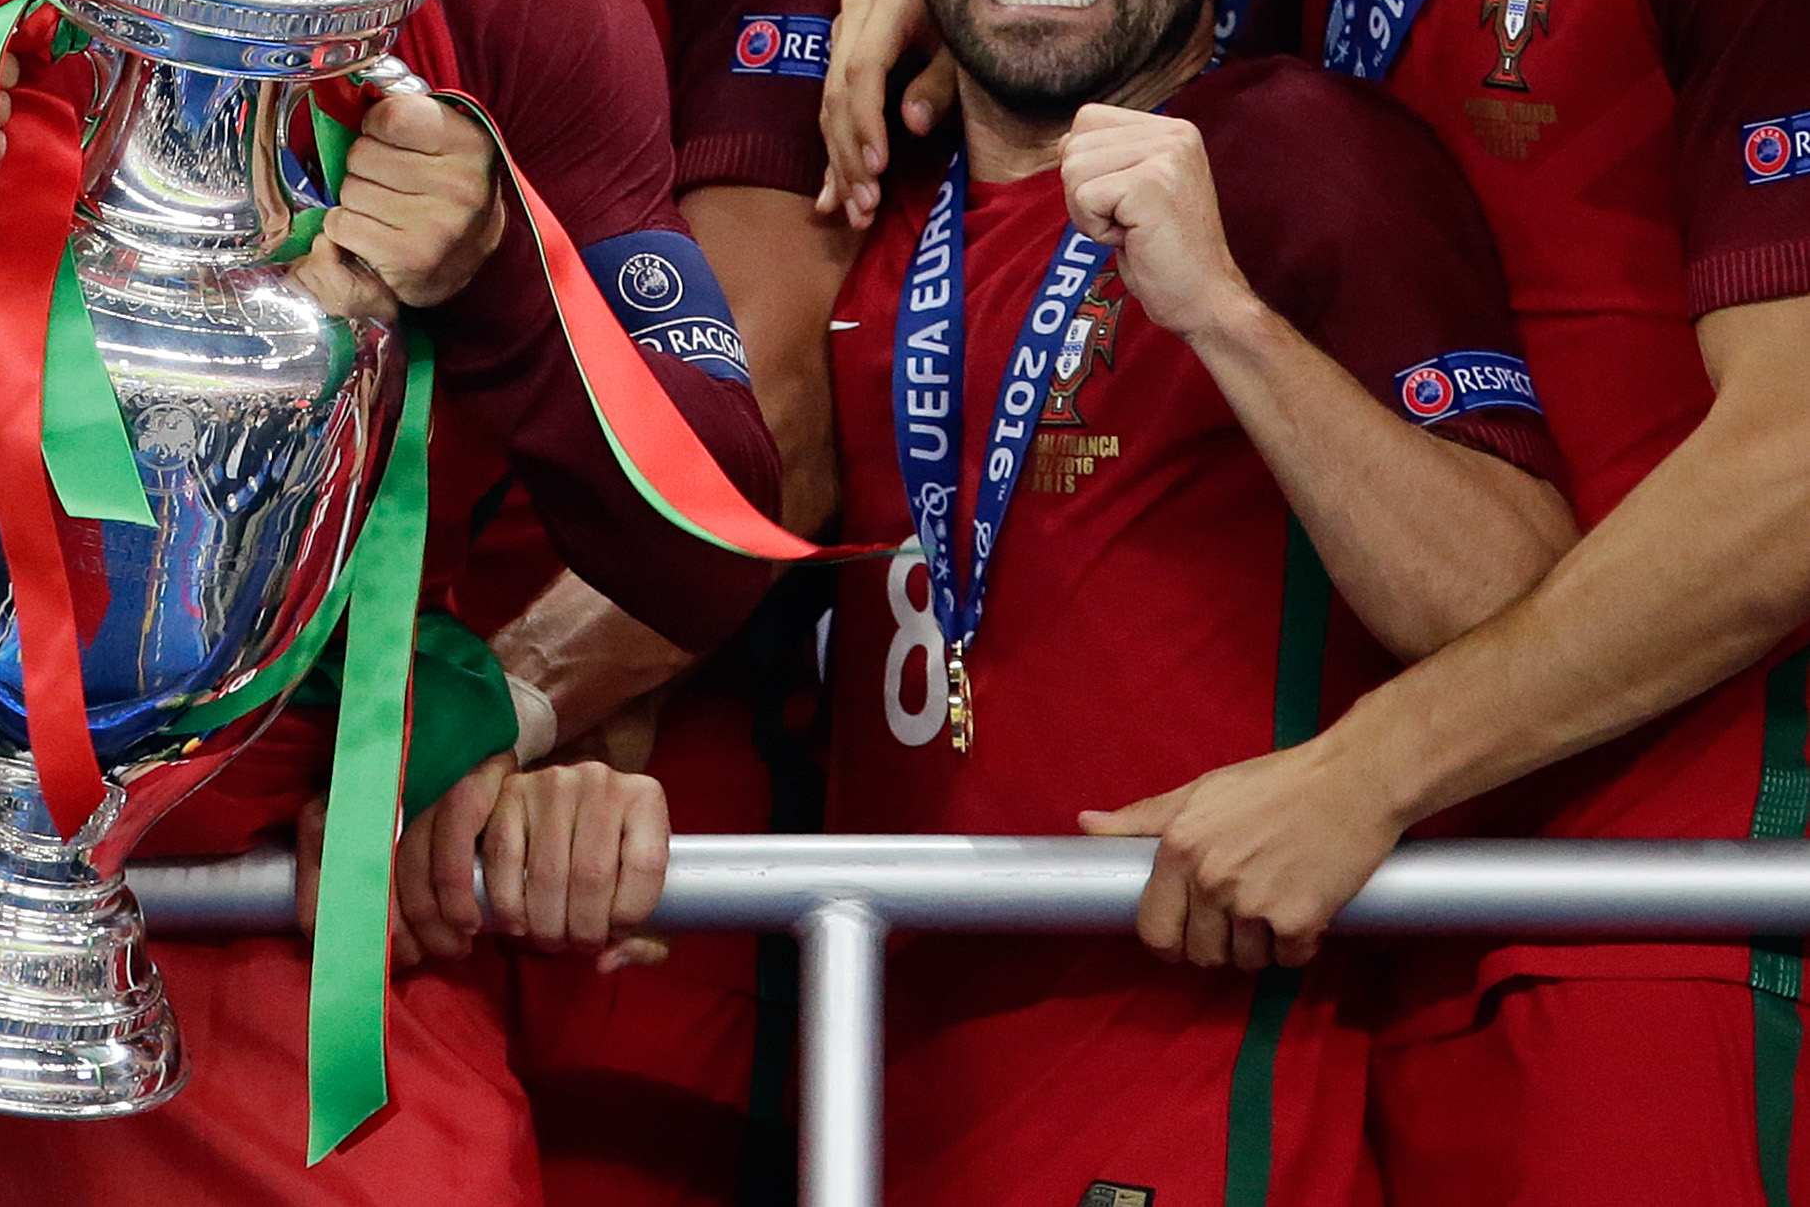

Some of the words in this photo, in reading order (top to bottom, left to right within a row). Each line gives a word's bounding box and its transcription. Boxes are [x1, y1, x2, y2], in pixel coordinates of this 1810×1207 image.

[626, 258, 662, 276] UEFA
[1031, 231, 1097, 336] URO
[905, 318, 952, 464] UEFA
[1408, 370, 1438, 389] UEFA
[1453, 365, 1537, 401] RESPECT
[884, 533, 950, 748] 8
